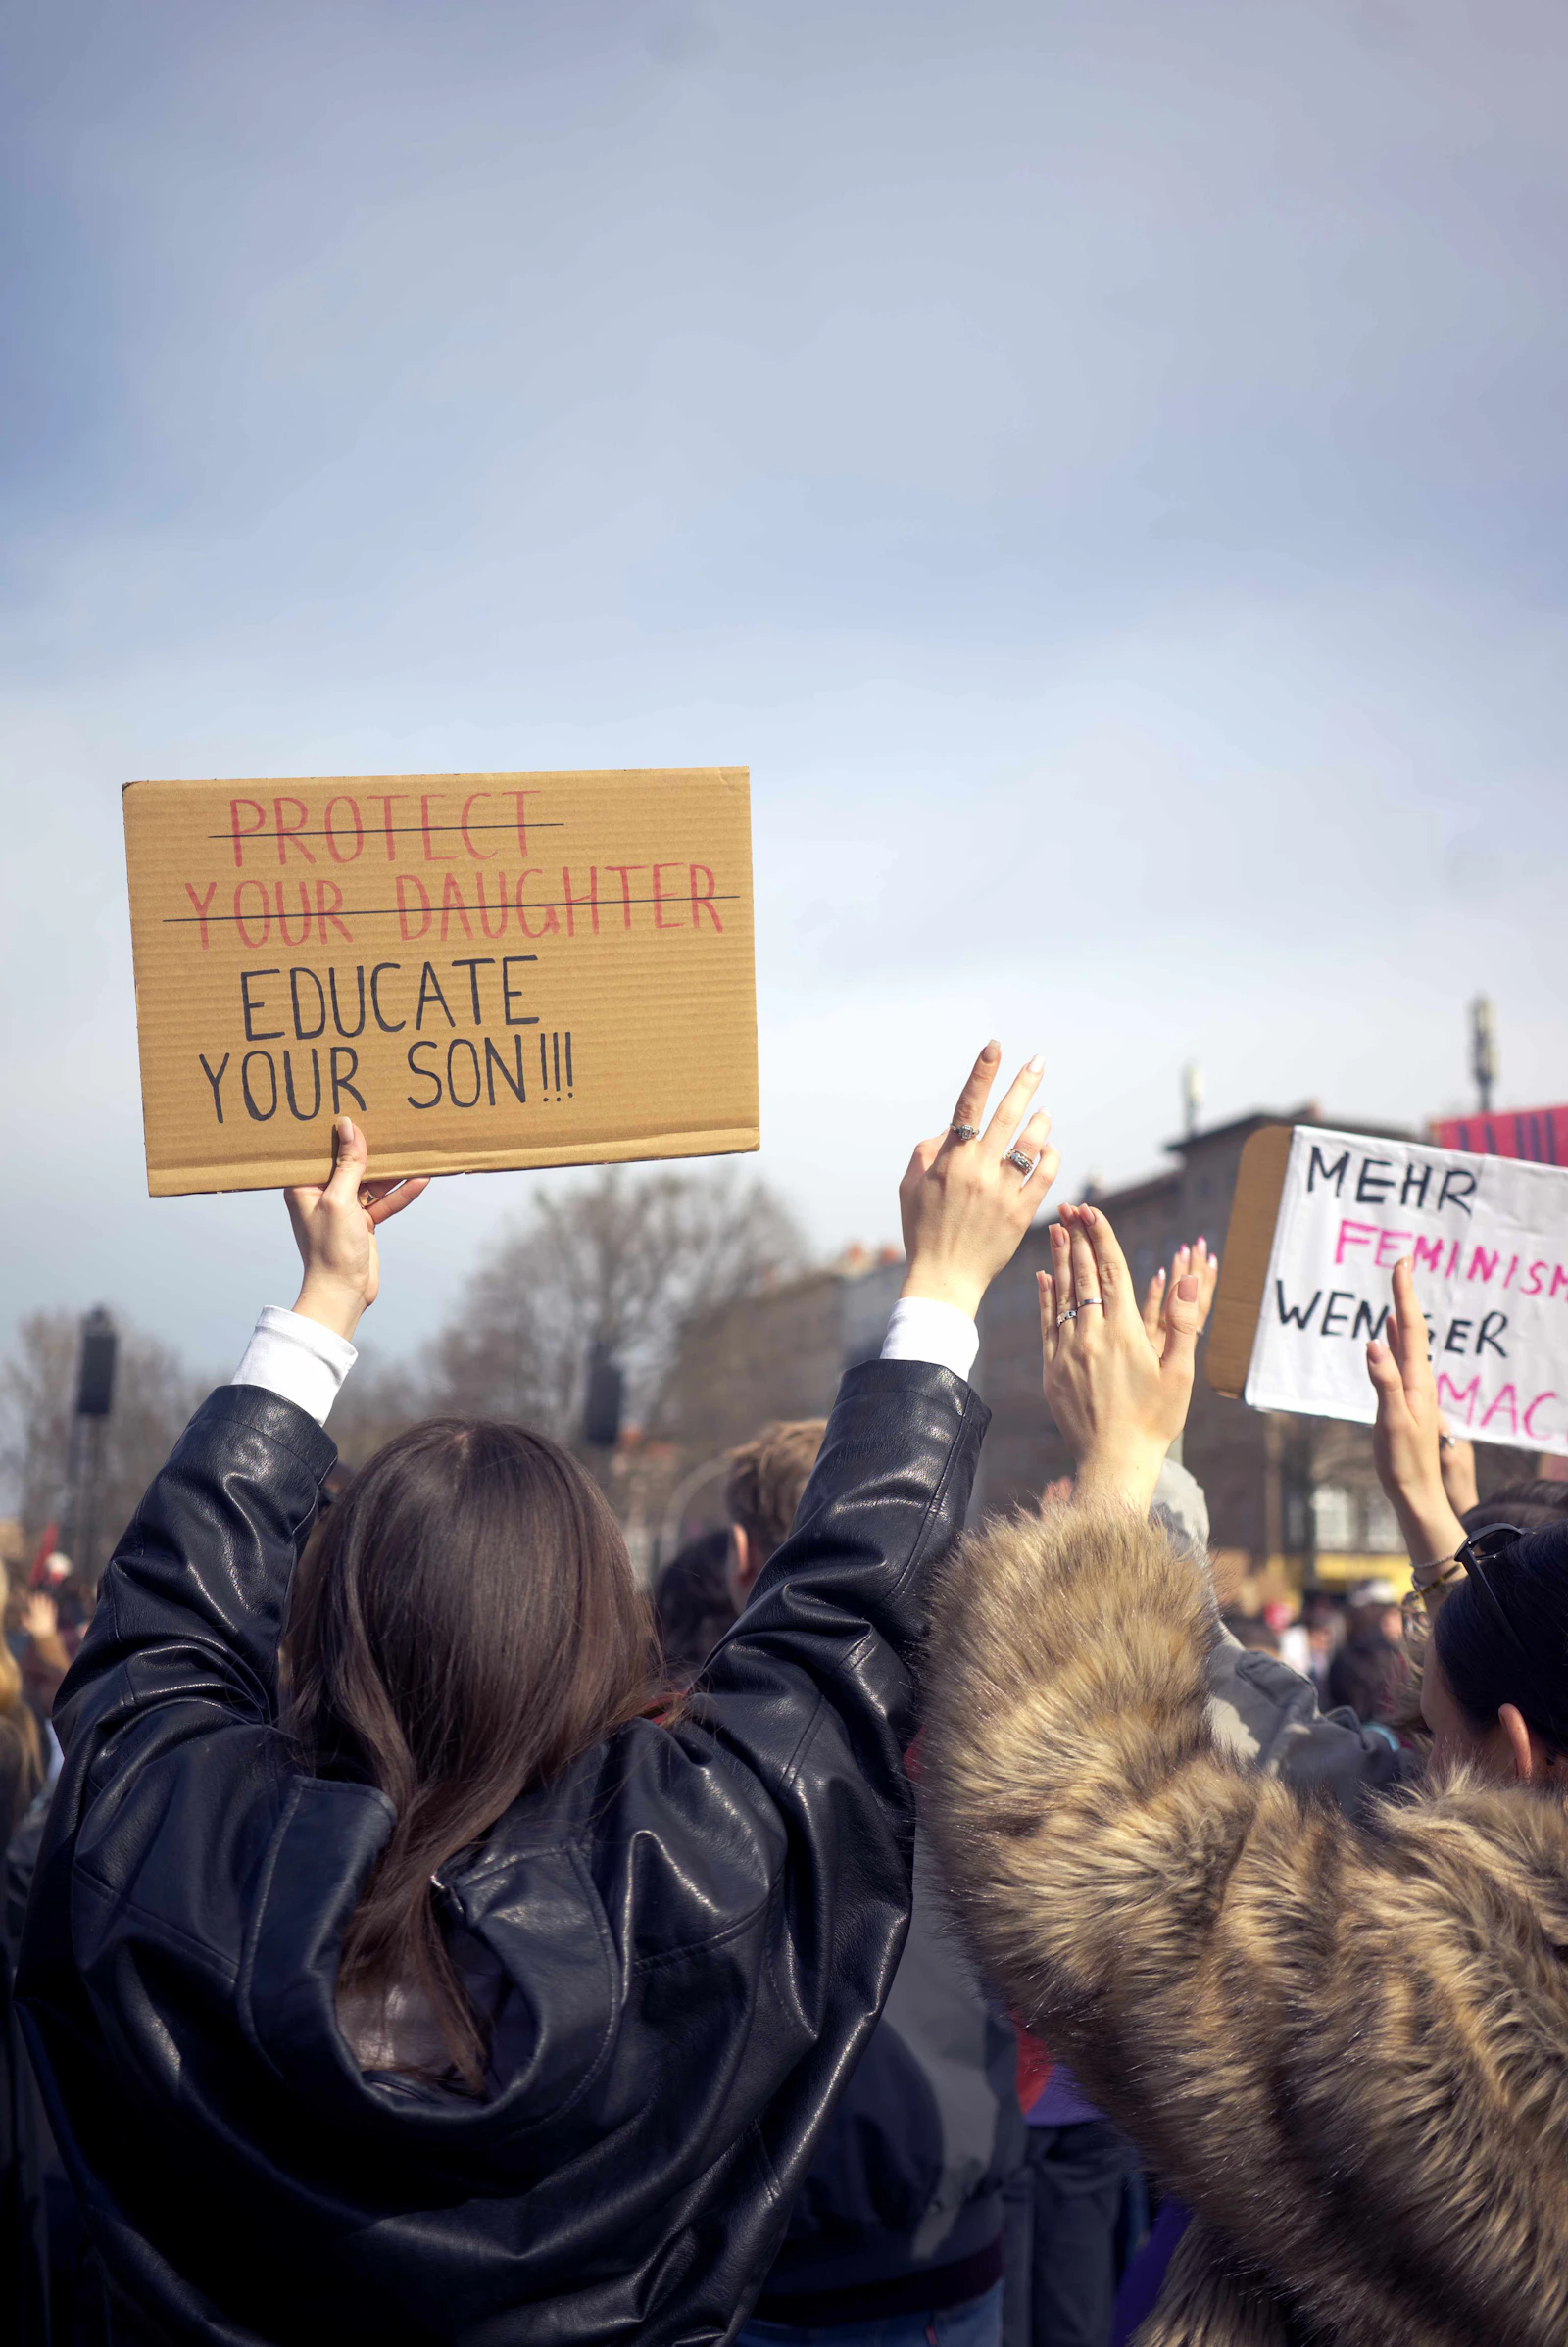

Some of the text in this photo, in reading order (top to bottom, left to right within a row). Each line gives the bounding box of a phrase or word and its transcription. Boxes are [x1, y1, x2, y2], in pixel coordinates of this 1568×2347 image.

[229, 789, 542, 867] PROTECT
[185, 863, 723, 951] YOUR DAUGHTER
[241, 955, 539, 1041] EDUCATE
[199, 1032, 574, 1123] YOUR SON!!!
[1306, 1146, 1477, 1215] MEHR
[1276, 1279, 1508, 1360] WENER
[1437, 1372, 1568, 1446] MAC
